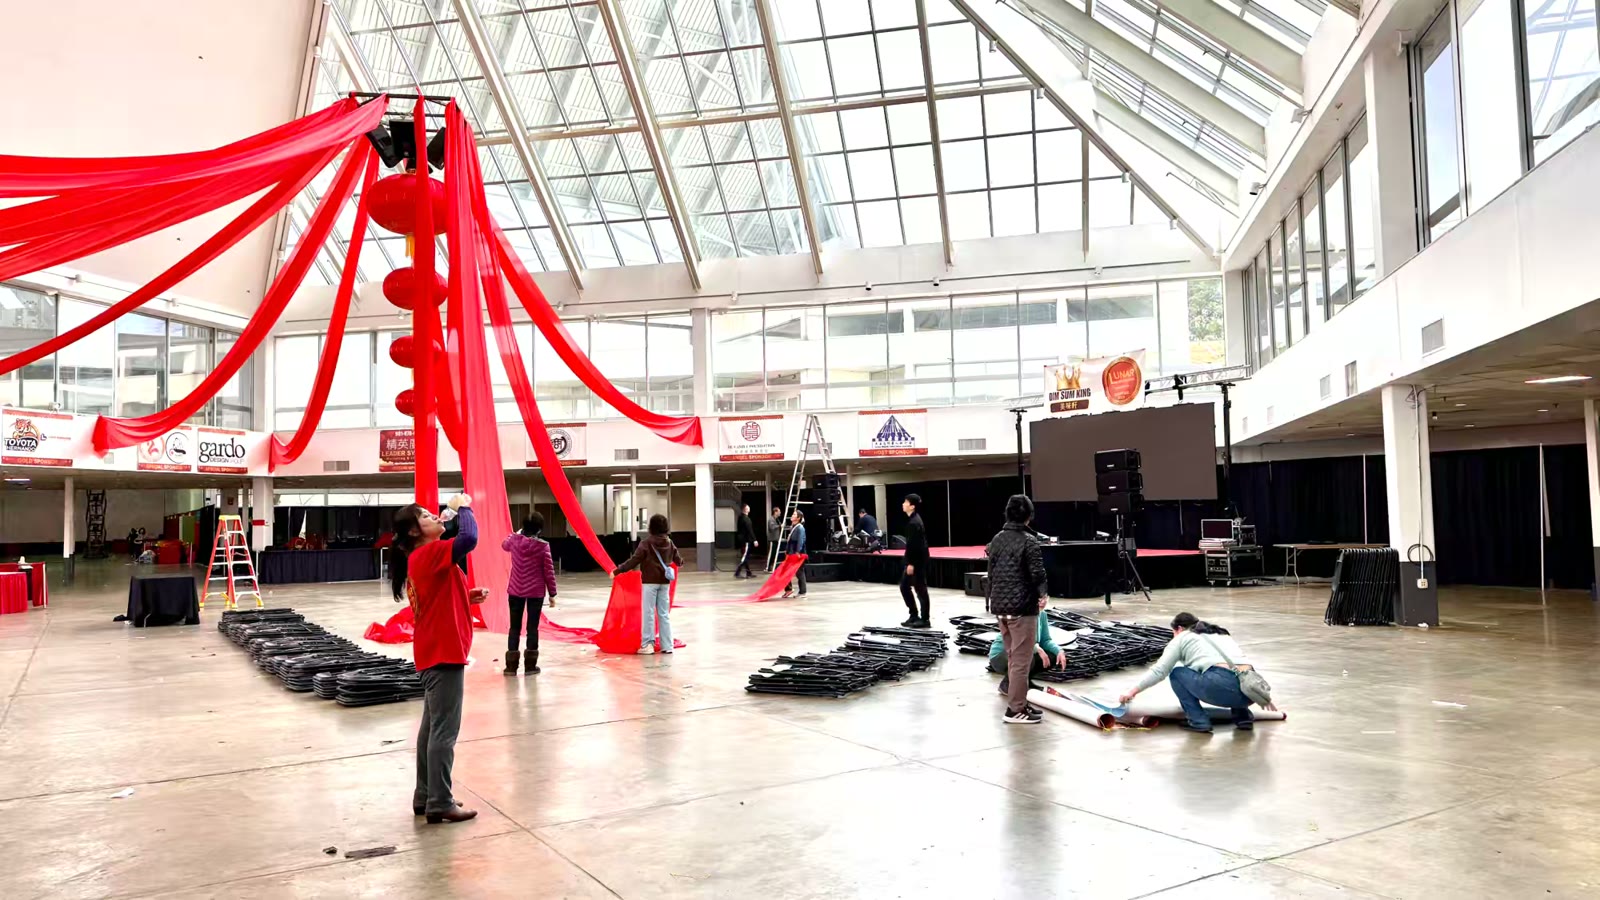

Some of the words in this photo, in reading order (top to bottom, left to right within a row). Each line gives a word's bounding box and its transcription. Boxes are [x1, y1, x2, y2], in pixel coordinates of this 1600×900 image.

[1109, 369, 1135, 384] LUNAR
[1049, 392, 1059, 401] DIM
[1060, 390, 1075, 400] SUM
[1076, 388, 1091, 398] KING
[4, 438, 37, 448] TOYOTA
[198, 437, 246, 463] gardo
